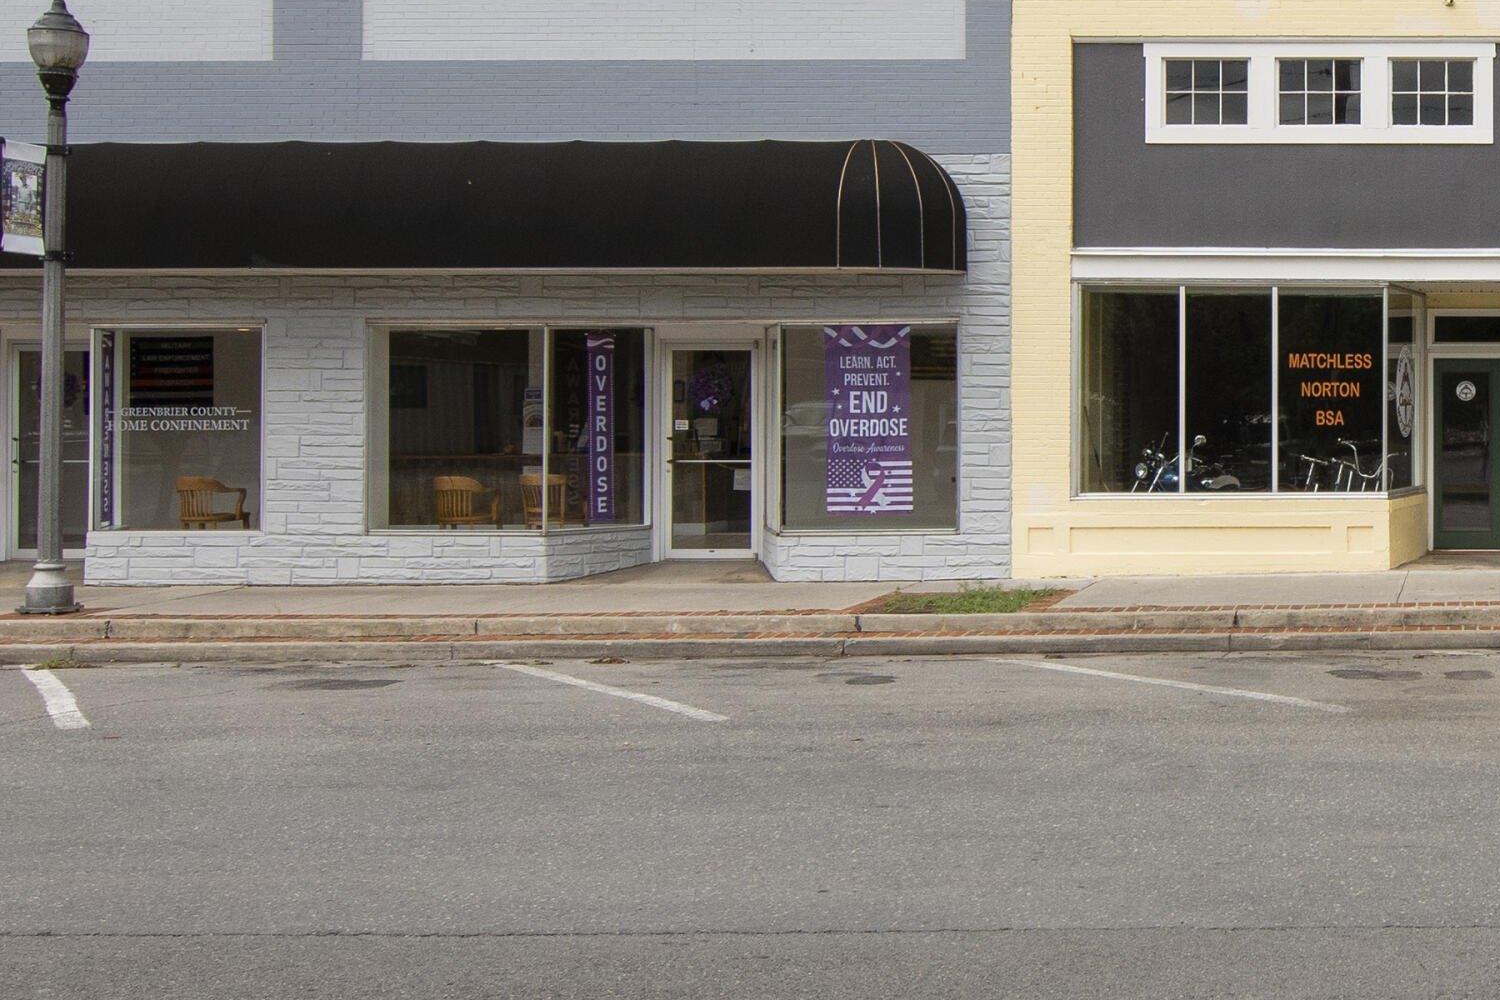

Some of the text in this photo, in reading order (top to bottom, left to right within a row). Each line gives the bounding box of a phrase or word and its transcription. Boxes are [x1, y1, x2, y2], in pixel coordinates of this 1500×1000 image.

[840, 355, 897, 369] LEARN. ACT.
[1288, 352, 1372, 369] MATCHLESS
[844, 373, 890, 386] PREVENT.
[1301, 382, 1360, 397] NORTON
[849, 390, 888, 414] END
[120, 406, 237, 417] GREENBRIER COUNTY
[1315, 410, 1344, 426] BSA
[150, 419, 250, 432] CONFINEMENT
[829, 418, 908, 437] OVERDOSE
[595, 354, 608, 513] OVERDOSE
